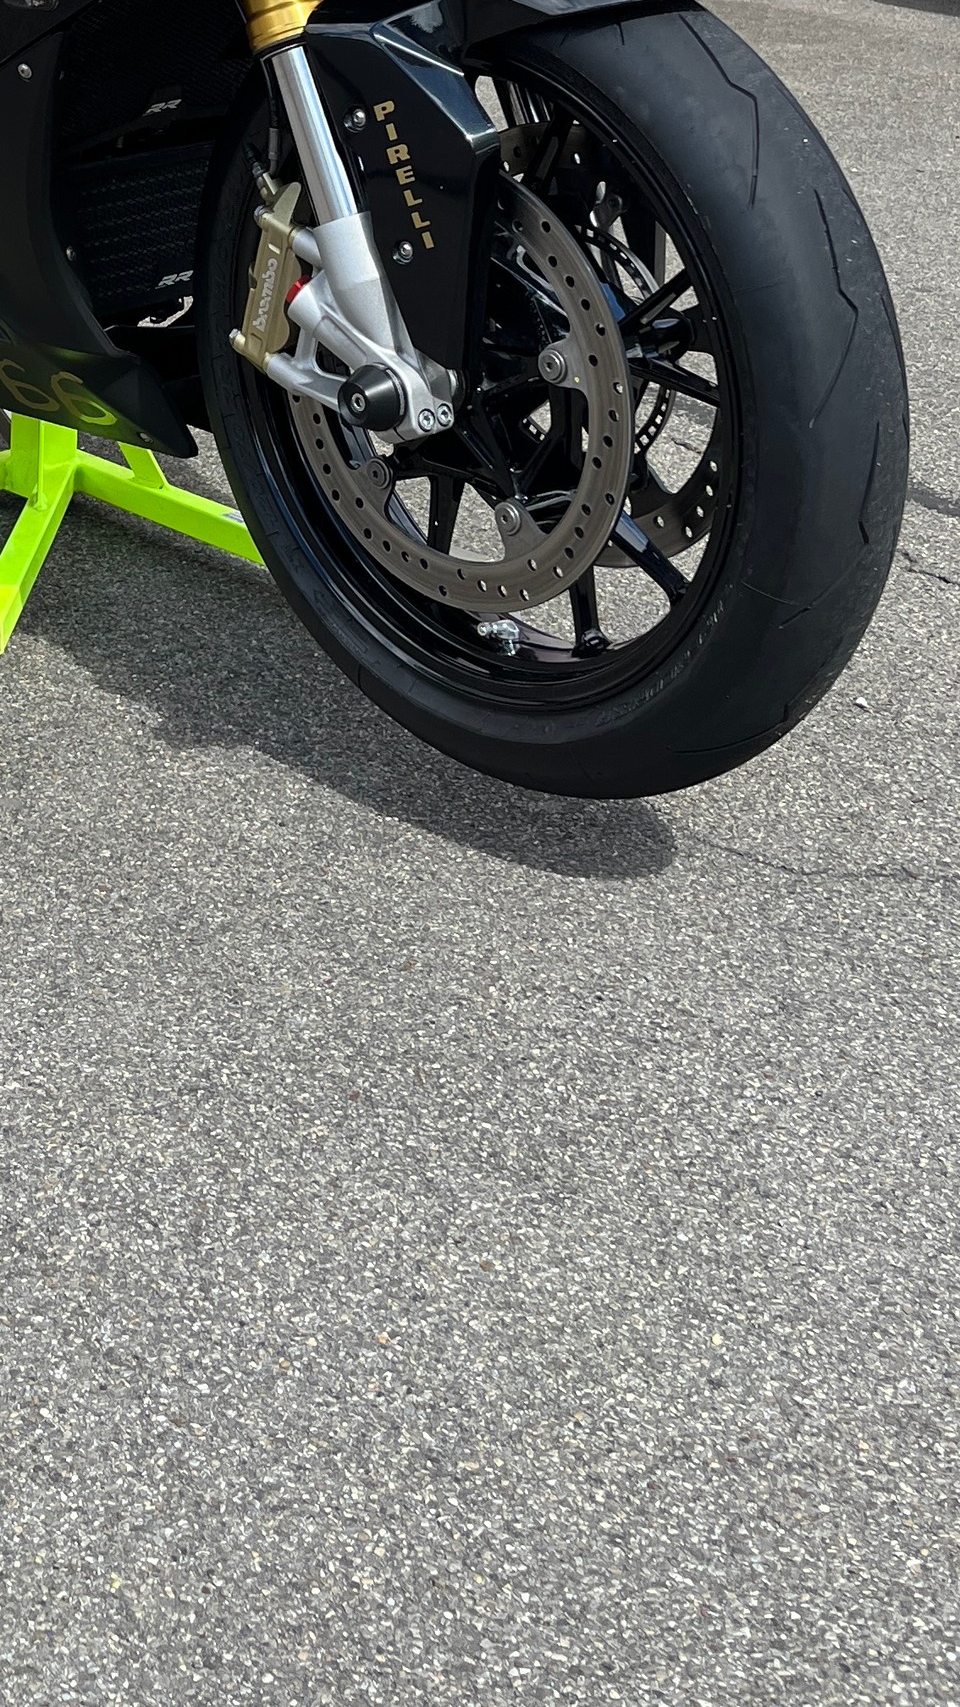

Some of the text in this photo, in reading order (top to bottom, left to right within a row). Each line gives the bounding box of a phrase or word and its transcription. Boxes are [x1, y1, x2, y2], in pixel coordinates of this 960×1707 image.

[145, 99, 182, 114] RR
[373, 100, 435, 250] PIRELLI
[157, 270, 194, 287] RR
[252, 257, 278, 332] brembo
